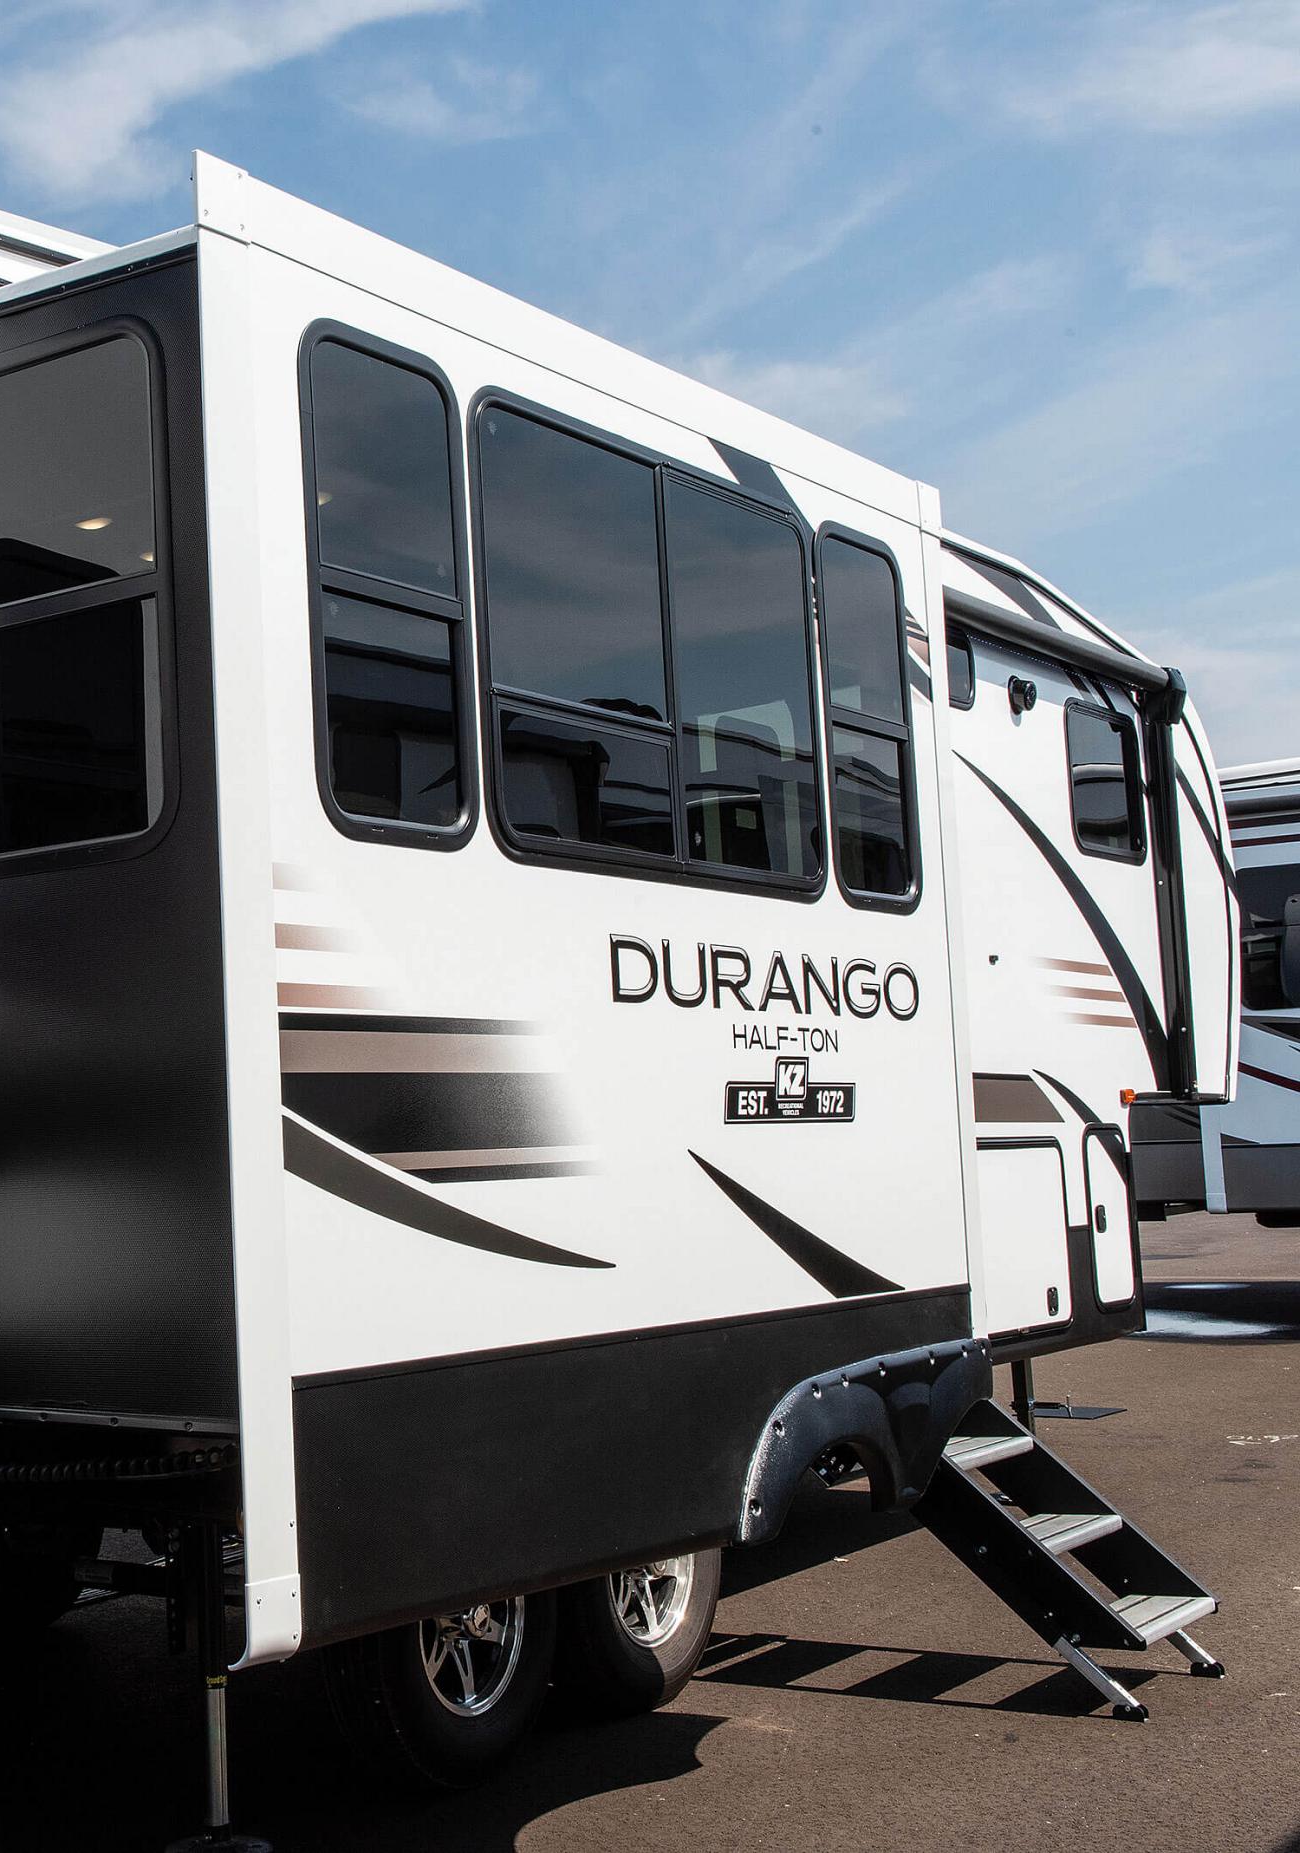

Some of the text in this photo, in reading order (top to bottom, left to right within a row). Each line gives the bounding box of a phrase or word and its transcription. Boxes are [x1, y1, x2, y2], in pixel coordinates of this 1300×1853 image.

[609, 933, 919, 1021] DURANGO
[733, 1024, 839, 1053] HALF-TON
[778, 1064, 805, 1096] KZ
[737, 1090, 845, 1116] EST. 1972
